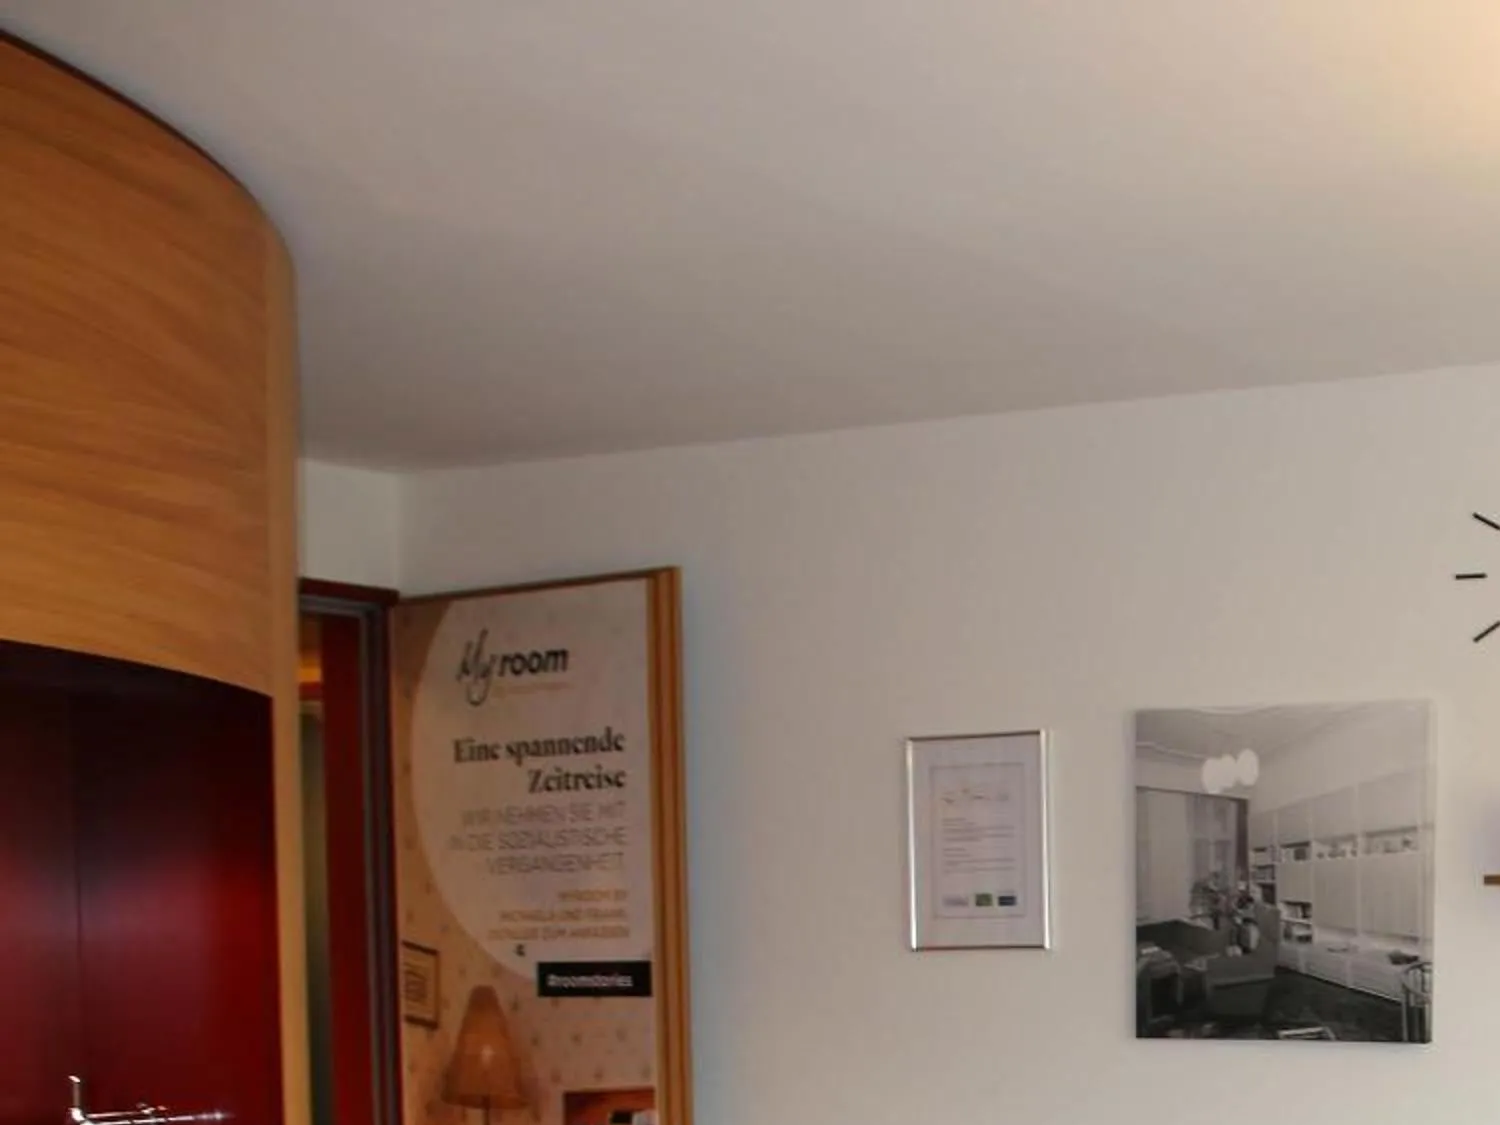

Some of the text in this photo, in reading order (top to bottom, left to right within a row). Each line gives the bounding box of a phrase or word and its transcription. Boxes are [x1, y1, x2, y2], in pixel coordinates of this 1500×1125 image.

[498, 648, 569, 677] room
[453, 726, 625, 767] Eine spannende
[528, 764, 626, 794] Zeitreise
